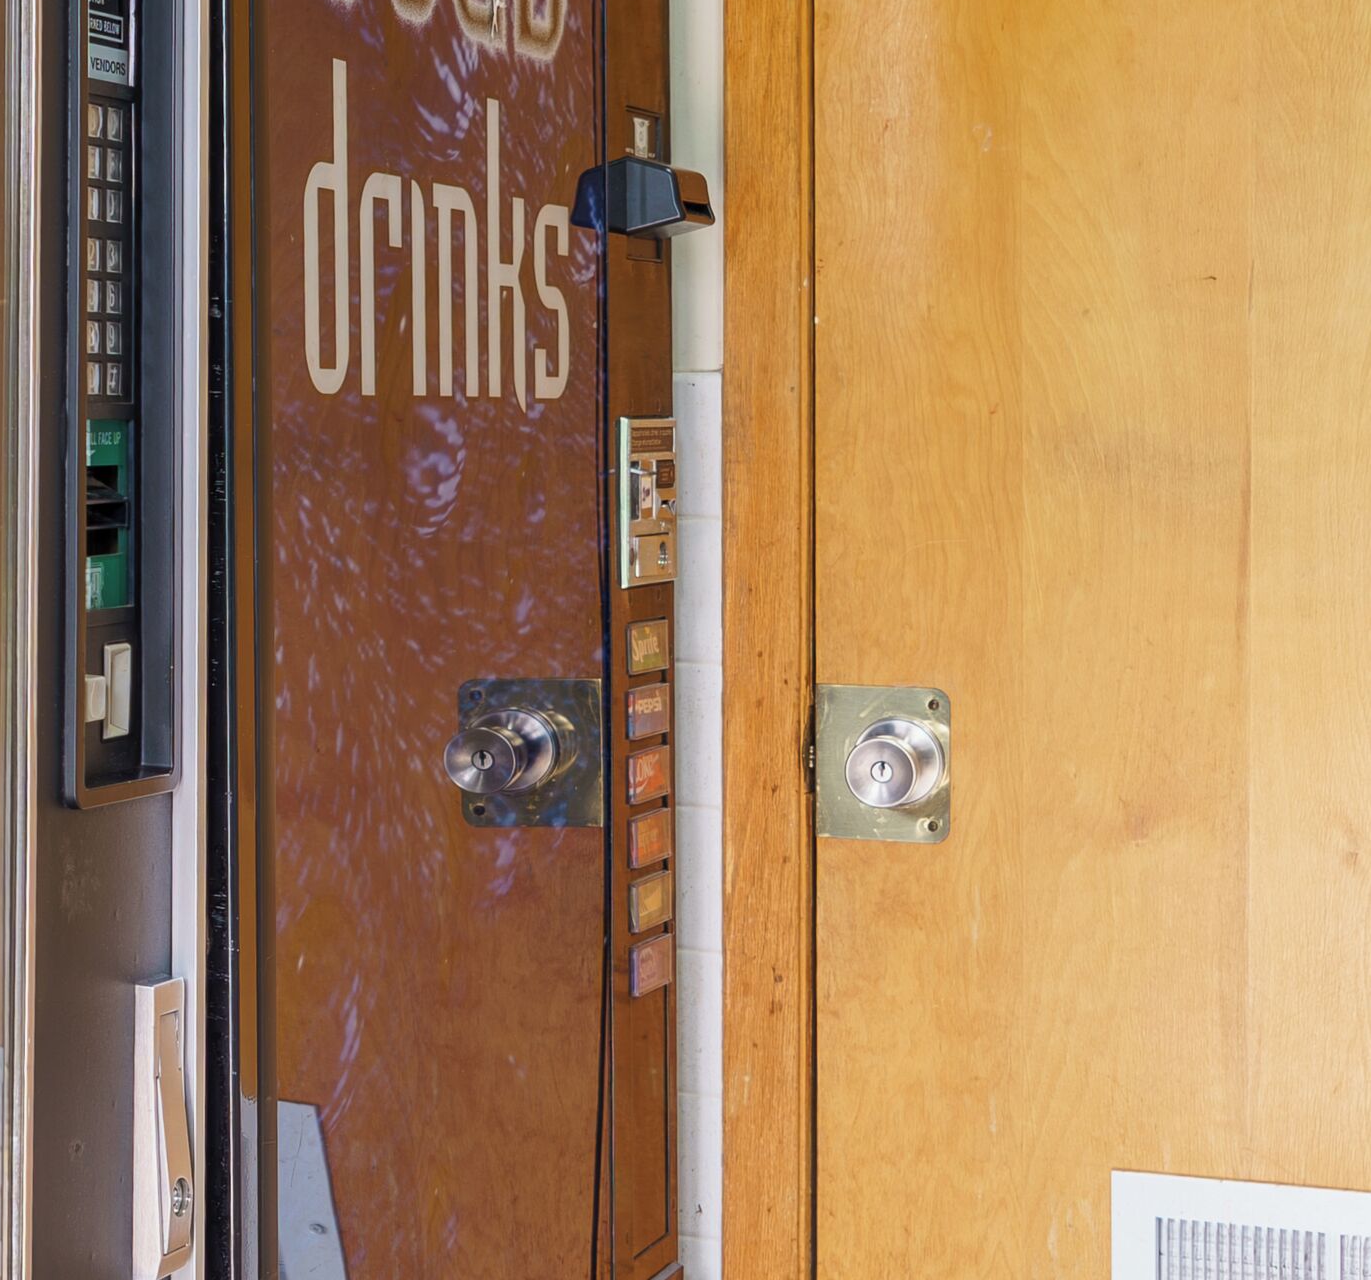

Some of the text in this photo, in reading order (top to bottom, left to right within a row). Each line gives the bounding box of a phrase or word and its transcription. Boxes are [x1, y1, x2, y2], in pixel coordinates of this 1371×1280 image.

[104, 20, 120, 35] BELOW
[89, 56, 126, 76] VENDORS
[302, 58, 570, 412] drinks
[98, 431, 112, 445] FACE
[113, 431, 121, 444] UP
[632, 628, 659, 663] Sprite
[635, 691, 662, 715] PEPSI
